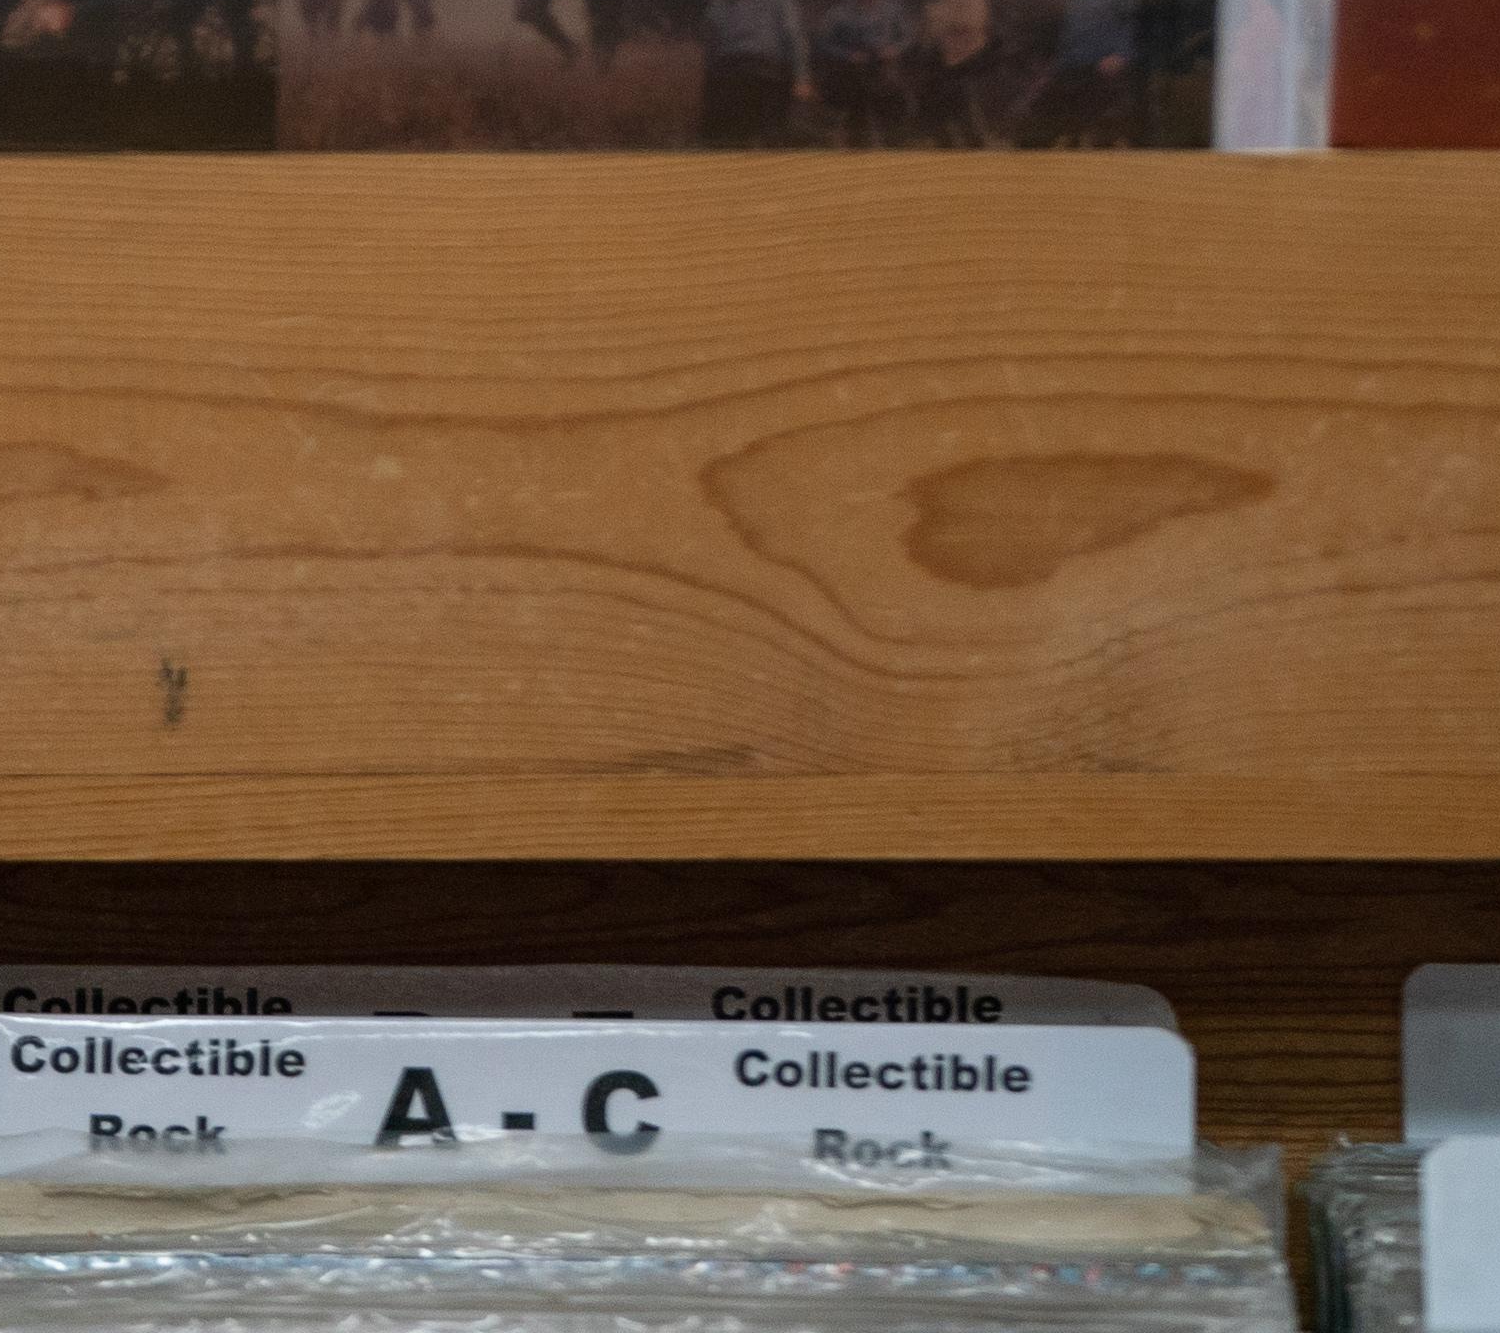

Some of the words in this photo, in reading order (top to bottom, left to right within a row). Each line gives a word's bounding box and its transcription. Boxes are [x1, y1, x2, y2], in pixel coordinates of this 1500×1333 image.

[2, 986, 293, 1015] Collectible
[711, 986, 1002, 1023] Collectible
[10, 1034, 307, 1078] Collectible
[734, 1048, 1031, 1093] Collectible
[375, 1066, 460, 1150] A
[582, 1069, 661, 1155] C
[88, 1113, 227, 1155] Rock
[812, 1128, 951, 1169] Rock
